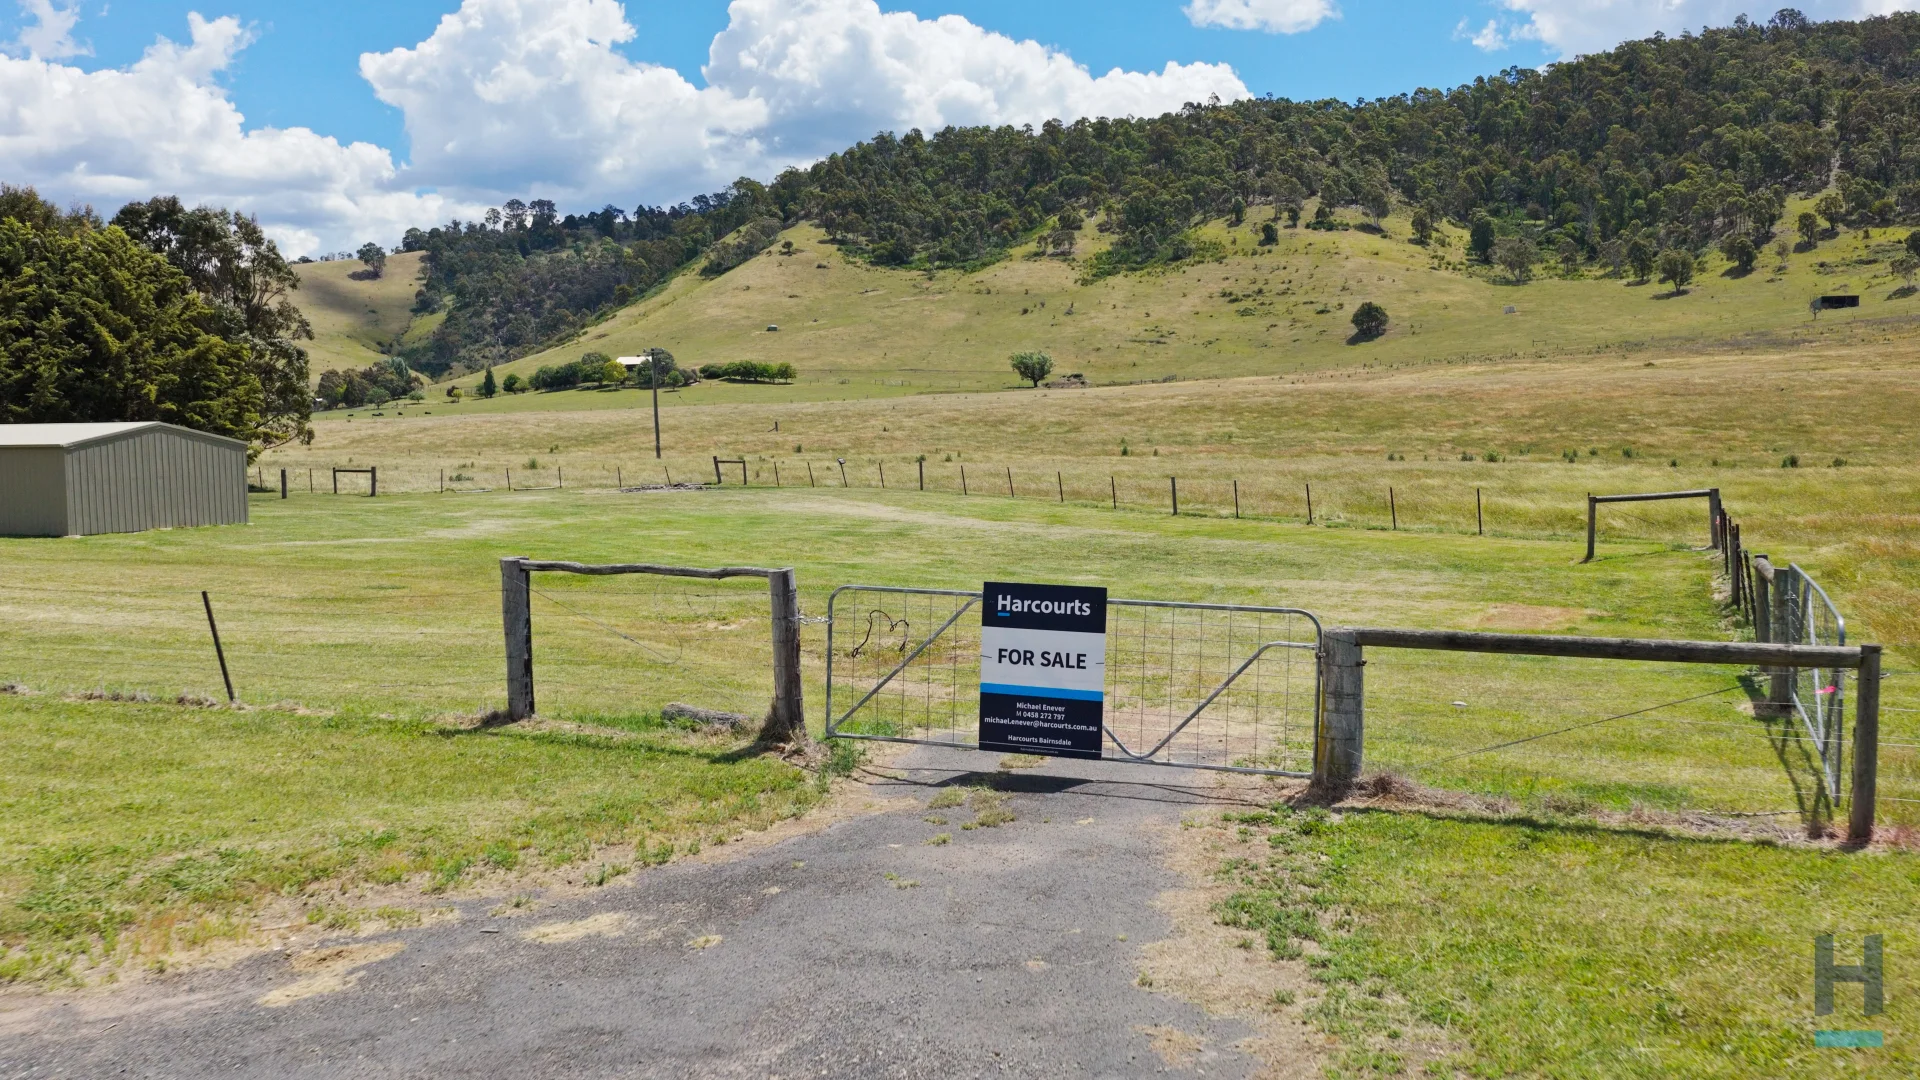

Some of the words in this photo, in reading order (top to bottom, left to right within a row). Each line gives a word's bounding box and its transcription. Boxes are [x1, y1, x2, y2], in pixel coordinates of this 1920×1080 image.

[997, 594, 1091, 616] Harcourts
[998, 648, 1034, 666] FOR
[1040, 650, 1087, 670] SALE
[1016, 702, 1041, 710] Michael
[1043, 704, 1065, 712] Enever
[984, 716, 1097, 731] michael.enever@harcourts.com.au
[1008, 735, 1038, 743] Harcourts
[1039, 737, 1071, 746] Bairnsdale
